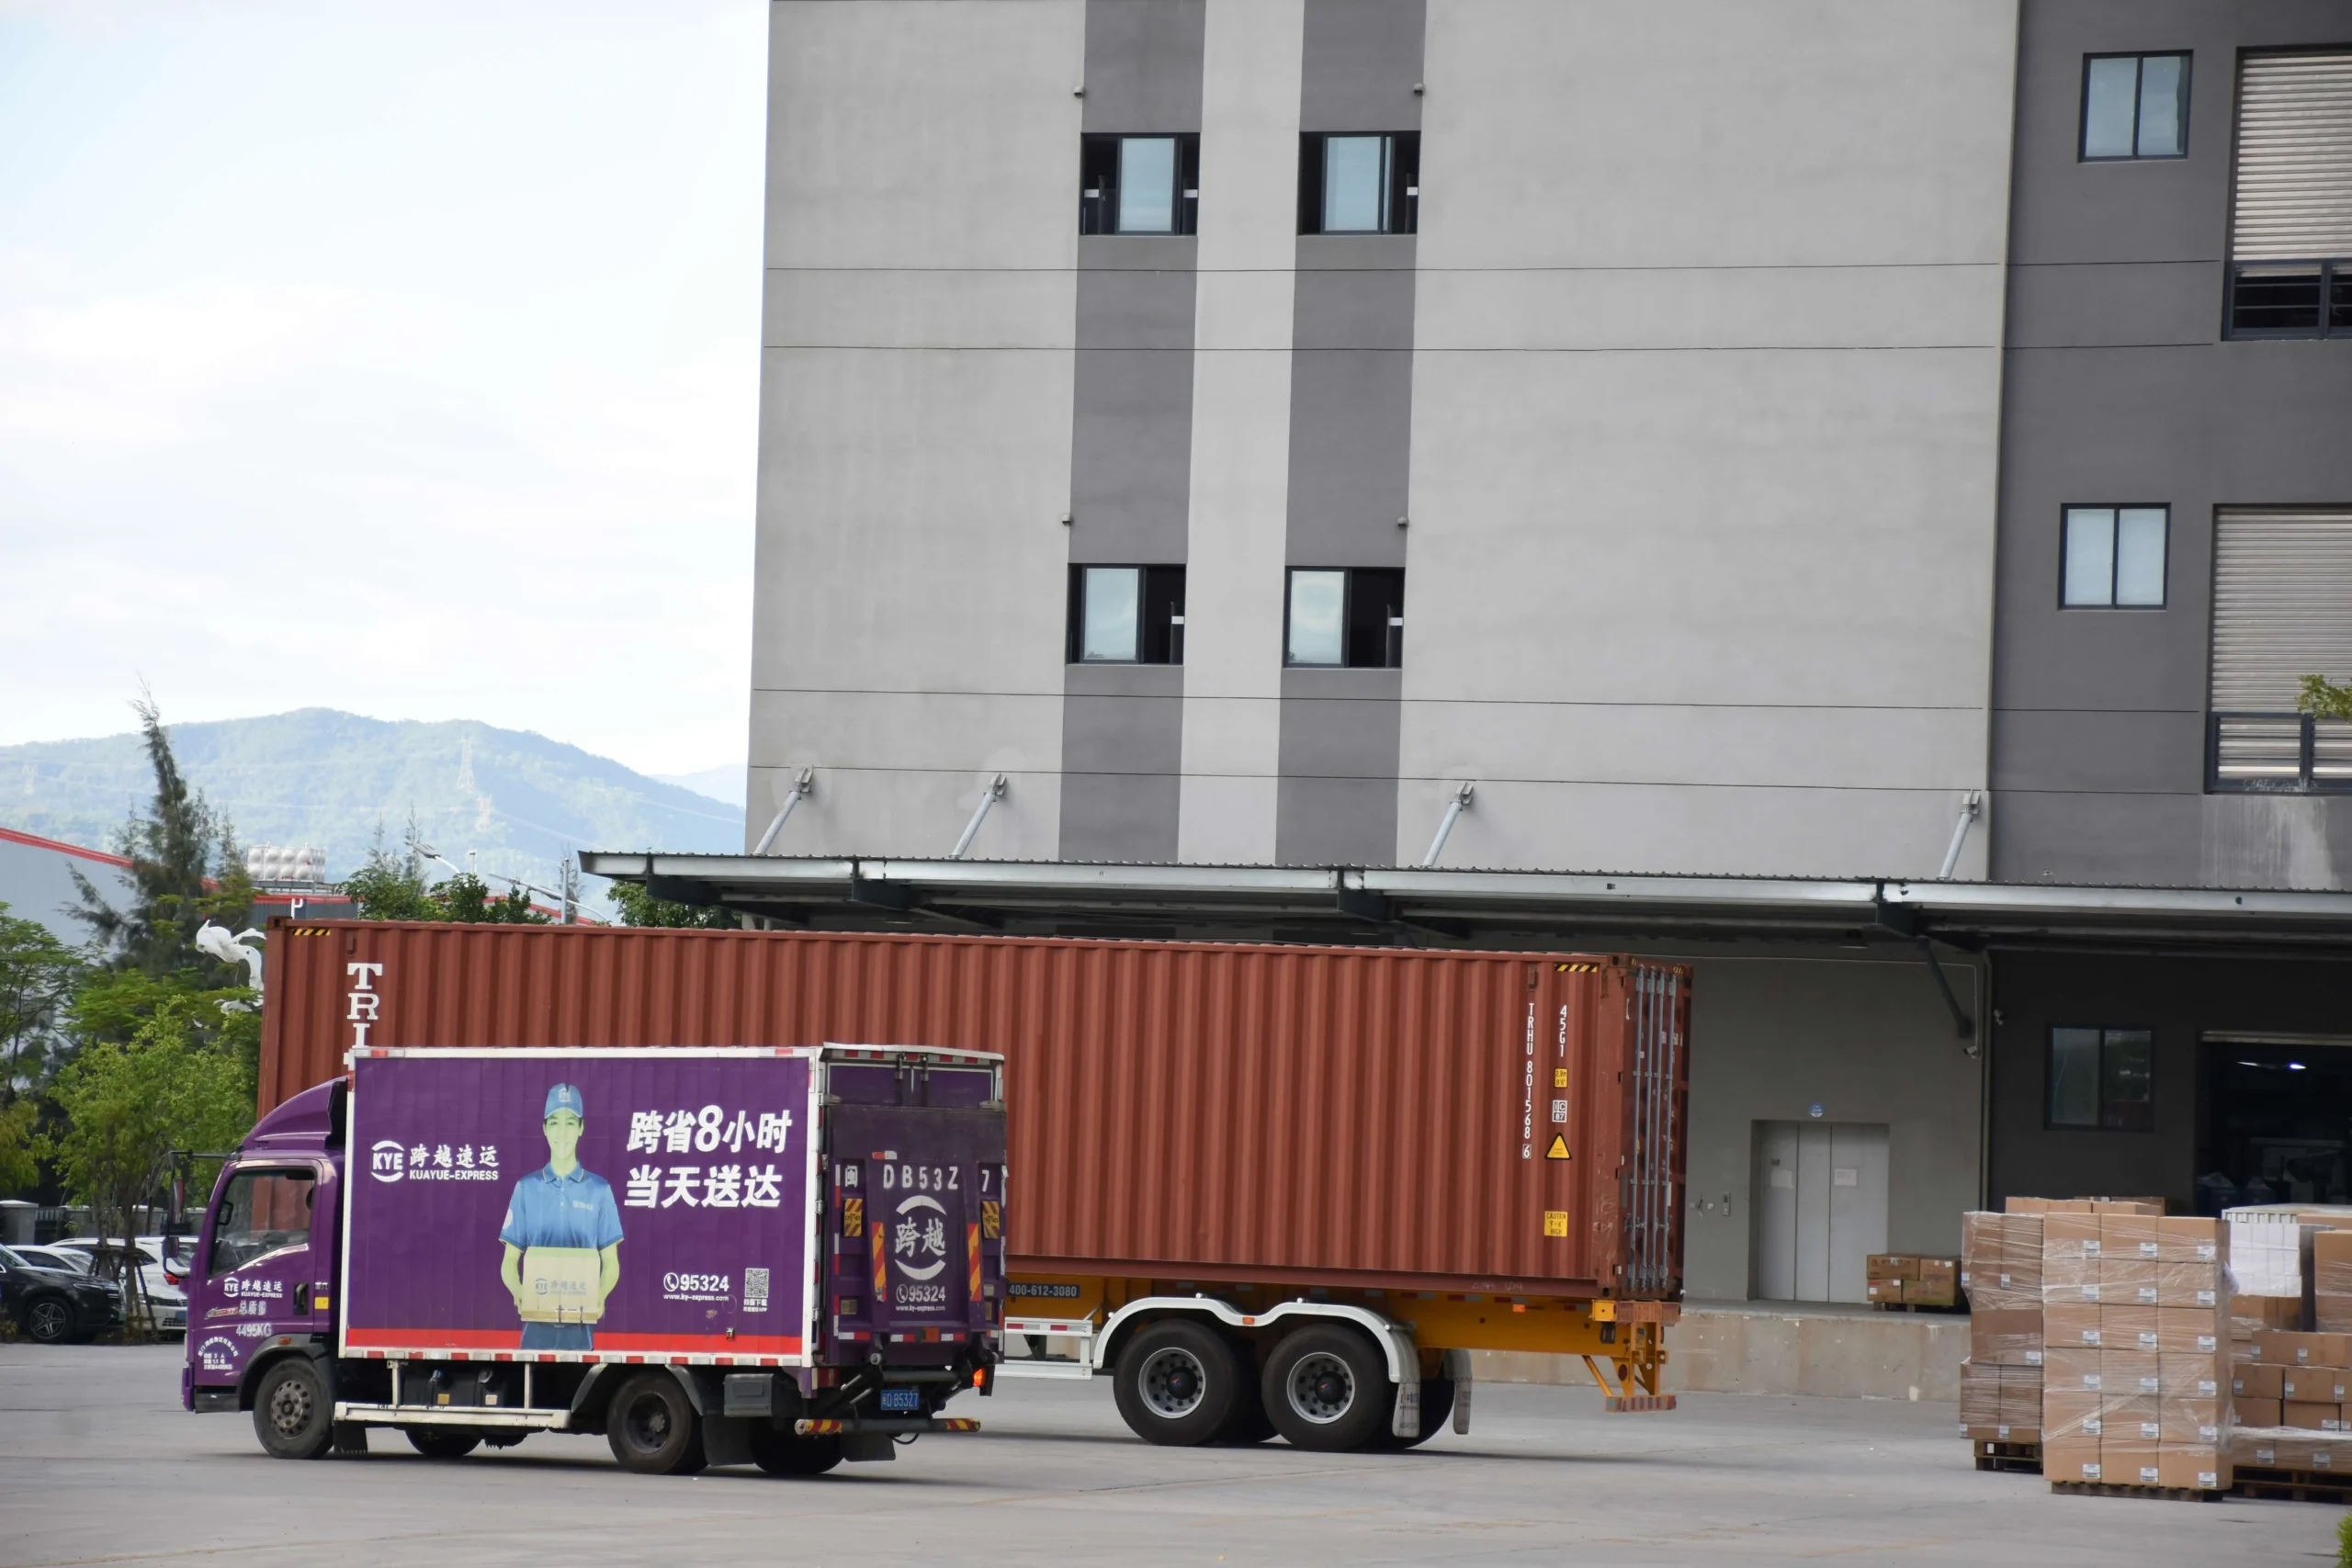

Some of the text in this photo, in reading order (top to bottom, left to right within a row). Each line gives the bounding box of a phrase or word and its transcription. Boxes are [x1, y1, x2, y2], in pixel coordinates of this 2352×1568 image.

[1526, 1002, 1535, 1055] TRHU
[1559, 1004, 1567, 1057] 45G1
[1523, 1060, 1533, 1139] 801568
[1555, 1112, 1565, 1121] 87
[626, 1104, 793, 1154] 跨省8小时
[372, 1152, 403, 1170] KYE
[409, 1143, 500, 1168] 跨越速运
[409, 1169, 499, 1180] KUAYUE-EXPRESS
[624, 1164, 783, 1209] 当天送达
[894, 1216, 947, 1258] 跨越
[223, 1282, 239, 1292] KYE
[679, 1273, 729, 1292] 95324
[1009, 1284, 1078, 1297] 400-612-3080
[662, 1293, 729, 1303] www.ky-express.com
[908, 1285, 946, 1303] 95324
[239, 1300, 267, 1315] 总质量
[235, 1323, 273, 1337] 4495KG
